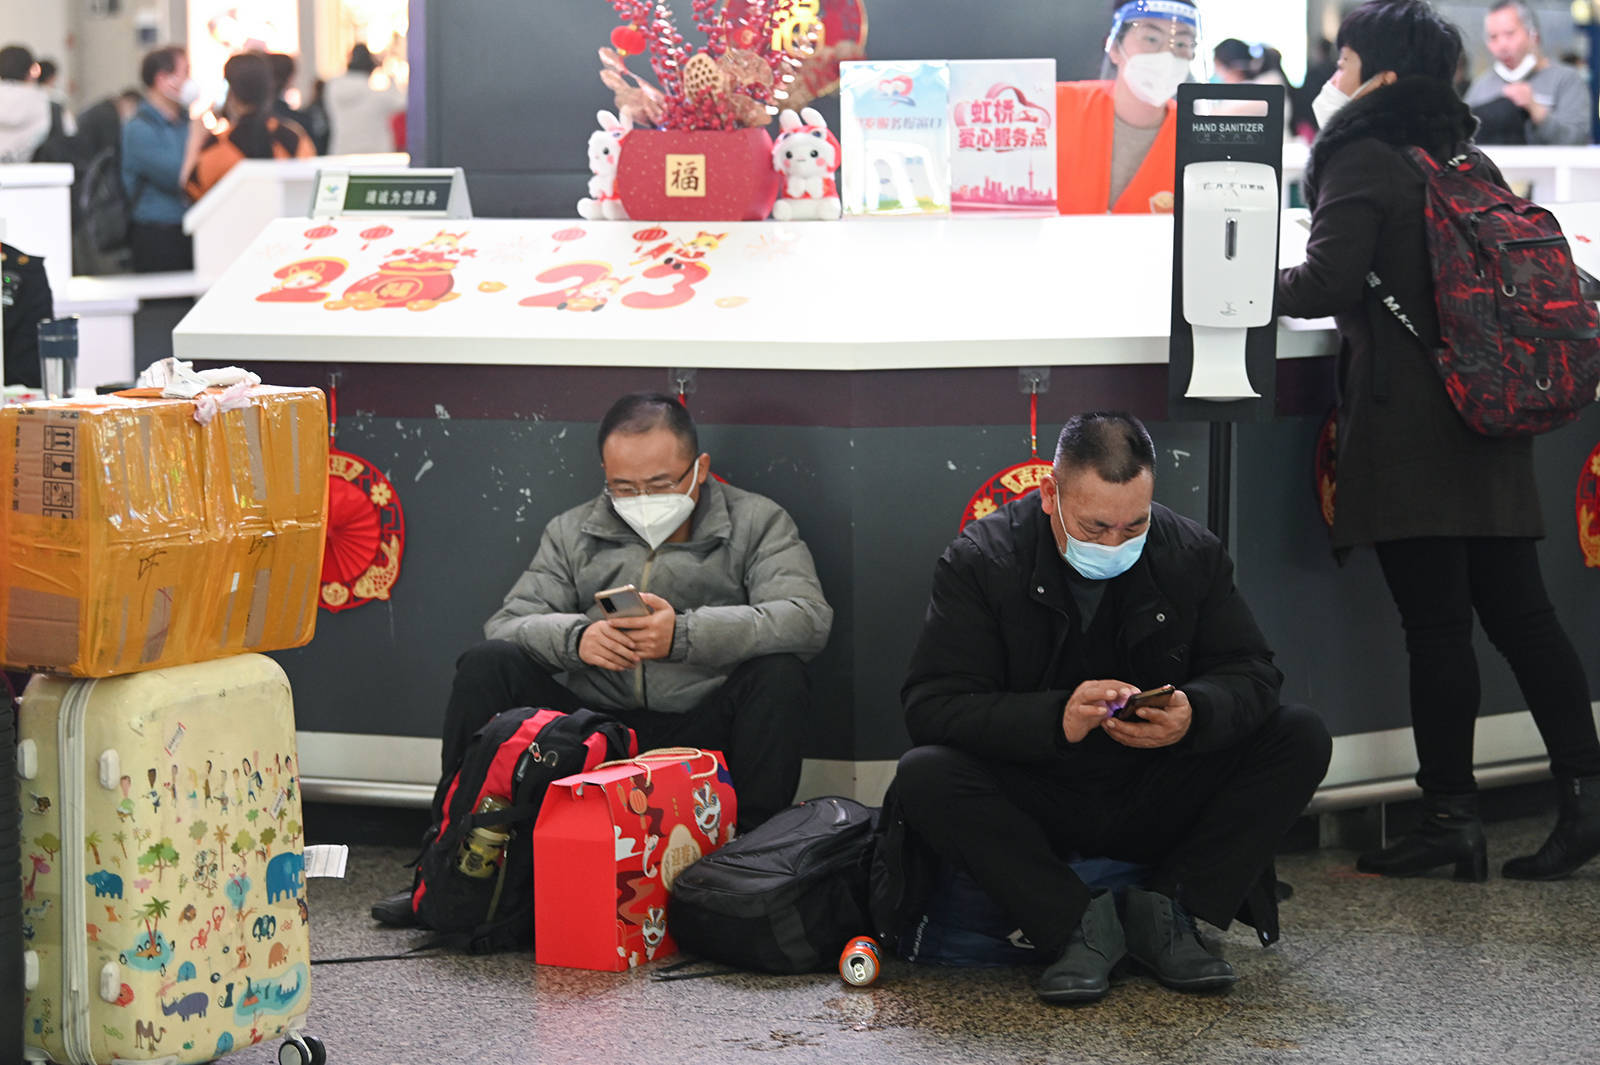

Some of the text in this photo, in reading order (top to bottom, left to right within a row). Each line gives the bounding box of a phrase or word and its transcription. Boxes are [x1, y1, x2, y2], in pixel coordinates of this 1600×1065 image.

[970, 99, 1014, 124] 虹桥
[958, 127, 1048, 149] 爱心服务点
[1192, 122, 1265, 133] HAND SANITIZER
[670, 160, 700, 191] 福
